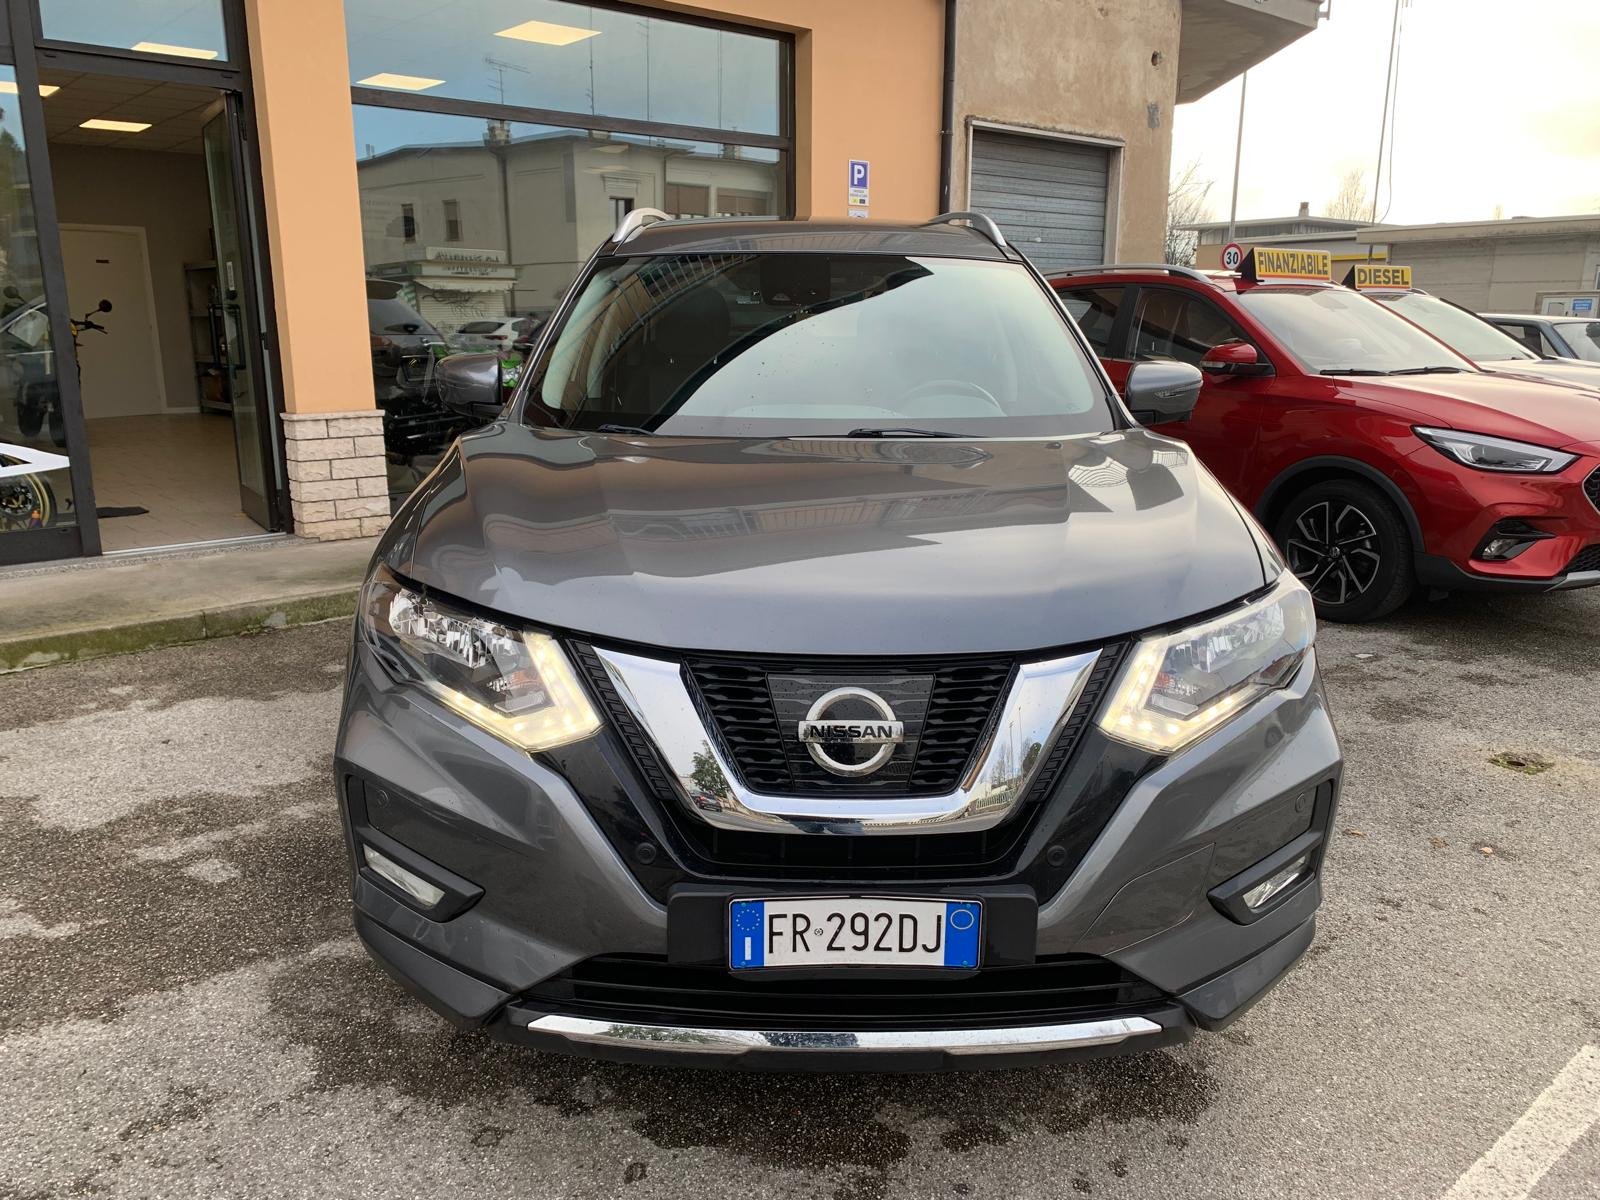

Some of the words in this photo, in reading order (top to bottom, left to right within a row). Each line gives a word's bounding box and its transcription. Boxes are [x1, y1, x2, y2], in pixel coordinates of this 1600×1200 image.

[853, 164, 865, 185] P
[1226, 251, 1239, 265] 30
[1257, 251, 1329, 275] FINANZIABILE
[1357, 268, 1410, 285] DIESEL
[809, 725, 893, 738] NISSAN
